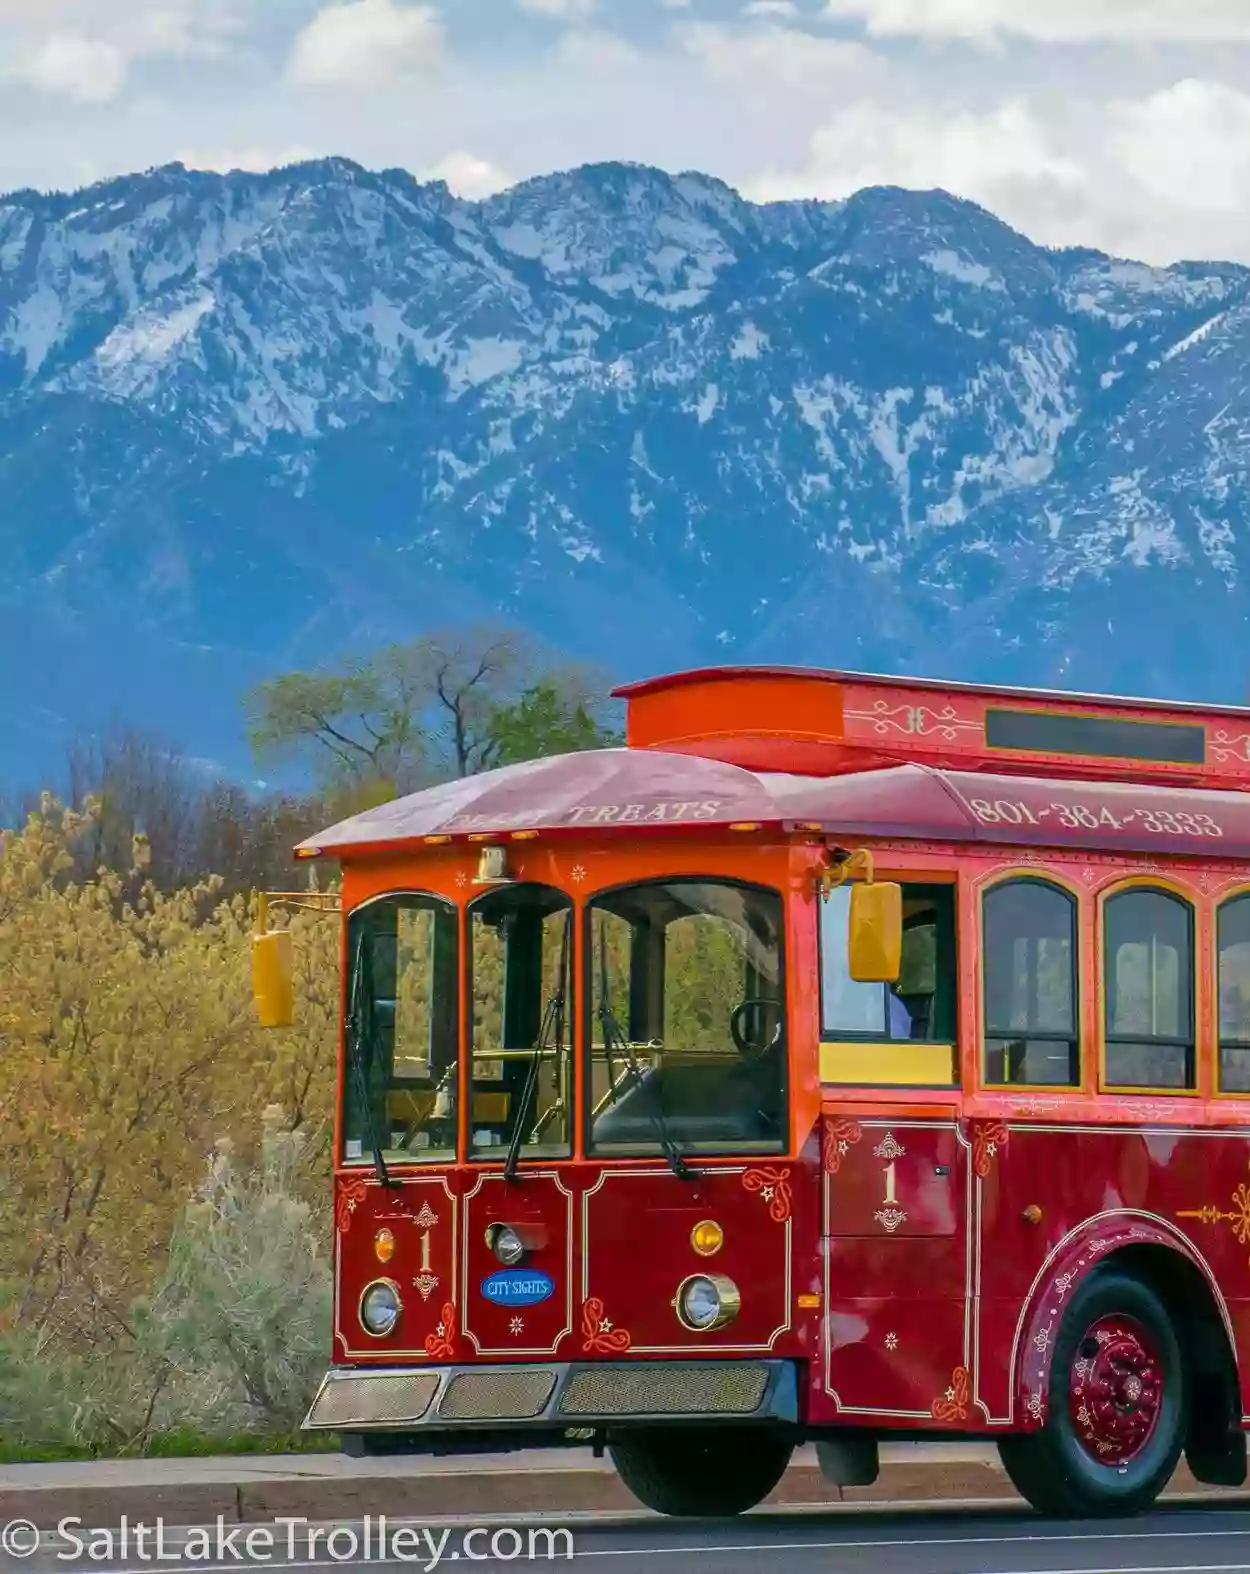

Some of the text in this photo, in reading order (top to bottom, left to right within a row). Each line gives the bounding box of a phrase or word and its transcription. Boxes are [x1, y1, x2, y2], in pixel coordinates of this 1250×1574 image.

[568, 800, 721, 823] TREATS
[971, 799, 1223, 837] 801-364-3333
[882, 1161, 899, 1204] 1
[420, 1230, 432, 1272] 1
[488, 1280, 548, 1295] CITY SIGHTS
